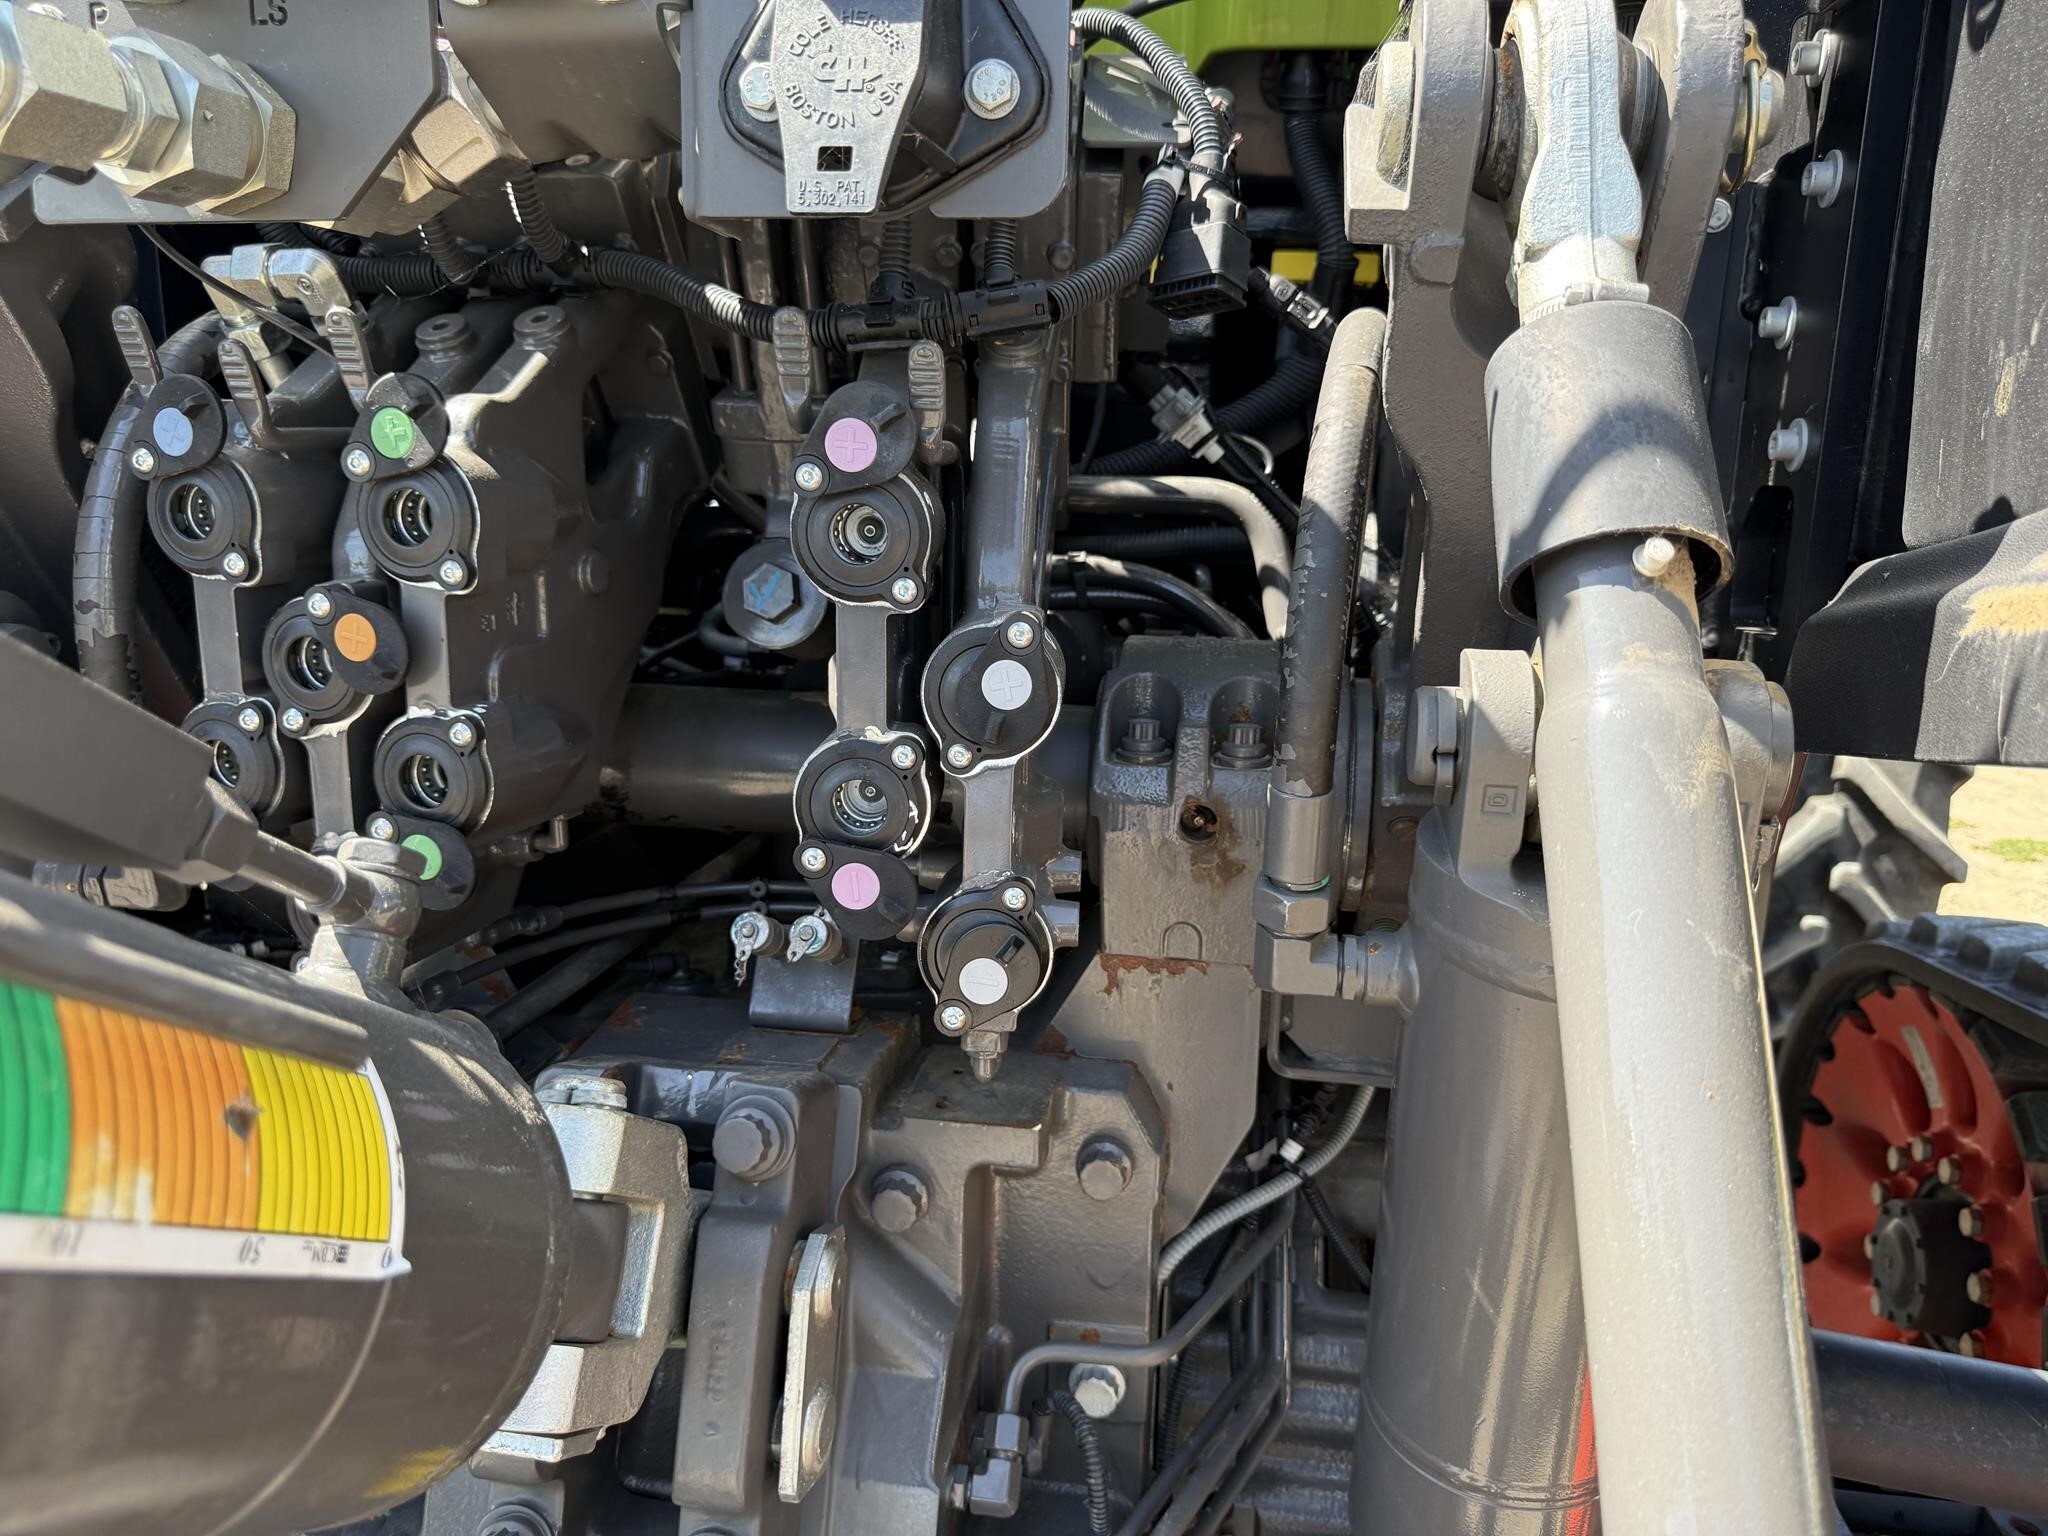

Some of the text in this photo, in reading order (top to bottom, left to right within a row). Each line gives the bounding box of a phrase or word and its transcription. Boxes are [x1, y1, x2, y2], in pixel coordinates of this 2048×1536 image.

[89, 2, 109, 29] P
[249, 0, 288, 26] LS
[788, 15, 832, 57] COLE
[785, 84, 856, 129] BOSTON
[865, 81, 904, 117] USA
[798, 190, 866, 207] 5,302,141
[799, 180, 827, 193] U.S.
[238, 1236, 266, 1264] 50
